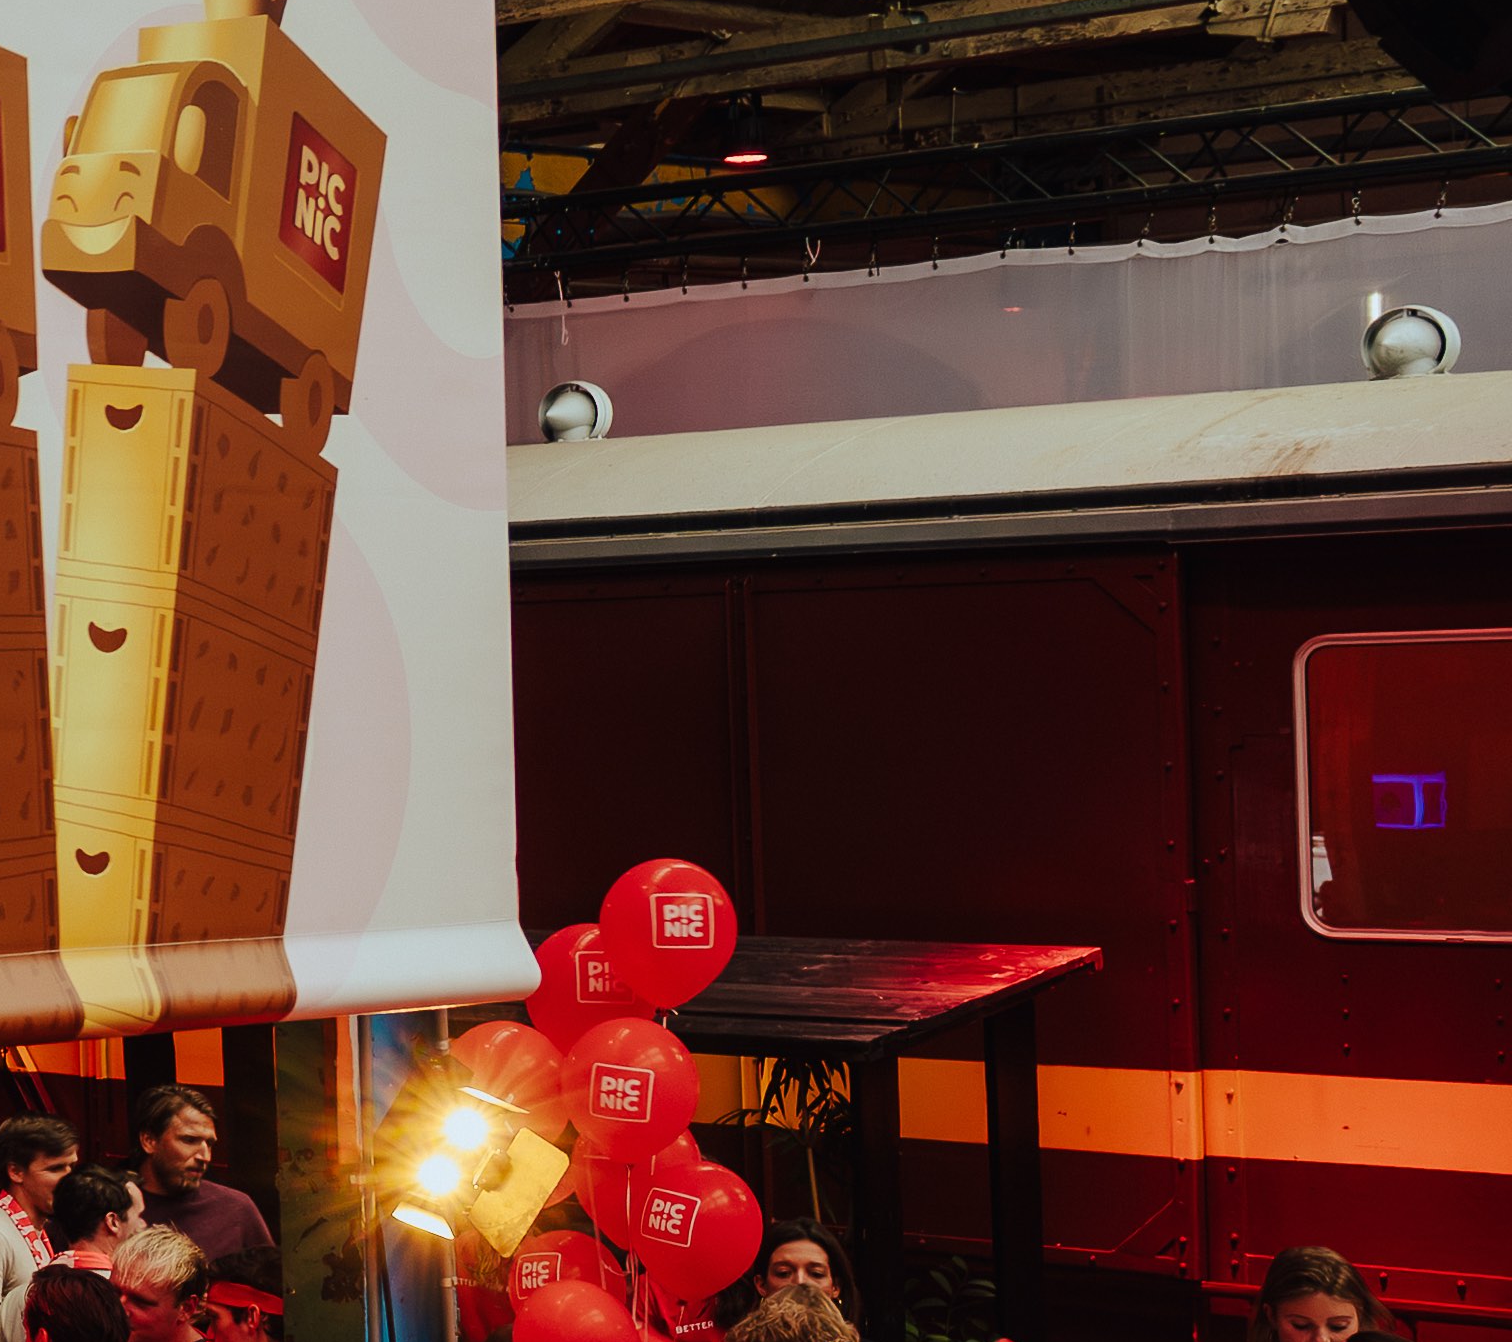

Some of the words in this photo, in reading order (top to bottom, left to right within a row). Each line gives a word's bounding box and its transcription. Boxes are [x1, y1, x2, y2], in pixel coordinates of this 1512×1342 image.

[300, 144, 345, 215] PIC
[663, 904, 704, 921] PIC
[600, 1076, 641, 1096] PIC
[651, 1198, 686, 1219] PIC
[522, 1261, 550, 1275] PIC
[675, 1320, 714, 1335] BETTER
